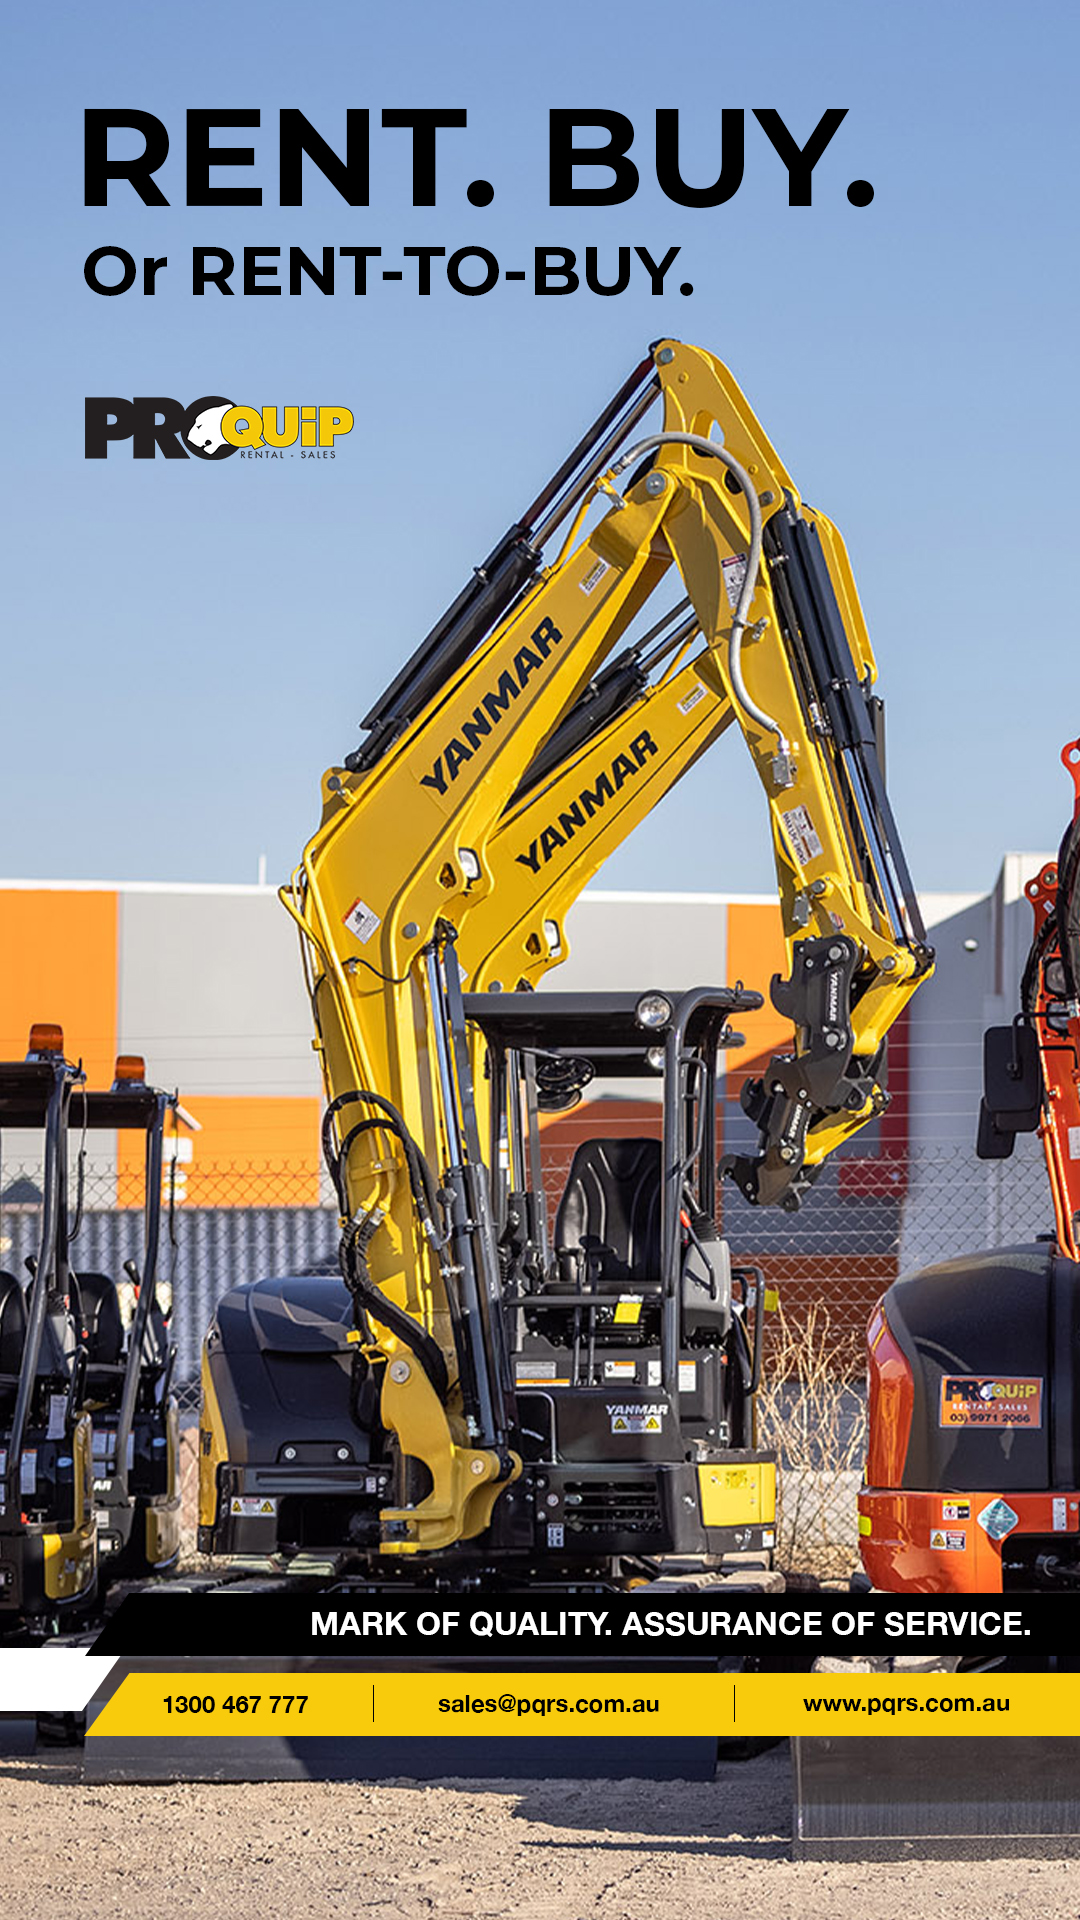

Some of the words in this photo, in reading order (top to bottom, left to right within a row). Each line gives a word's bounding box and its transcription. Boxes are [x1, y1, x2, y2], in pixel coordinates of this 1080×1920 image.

[420, 616, 563, 796] YANMAR
[515, 730, 659, 874] YANMAR
[828, 971, 840, 1022] YANMAR
[605, 1404, 669, 1416] YANMAR
[952, 1403, 988, 1411] RENTAL
[999, 1403, 1028, 1412] SALES
